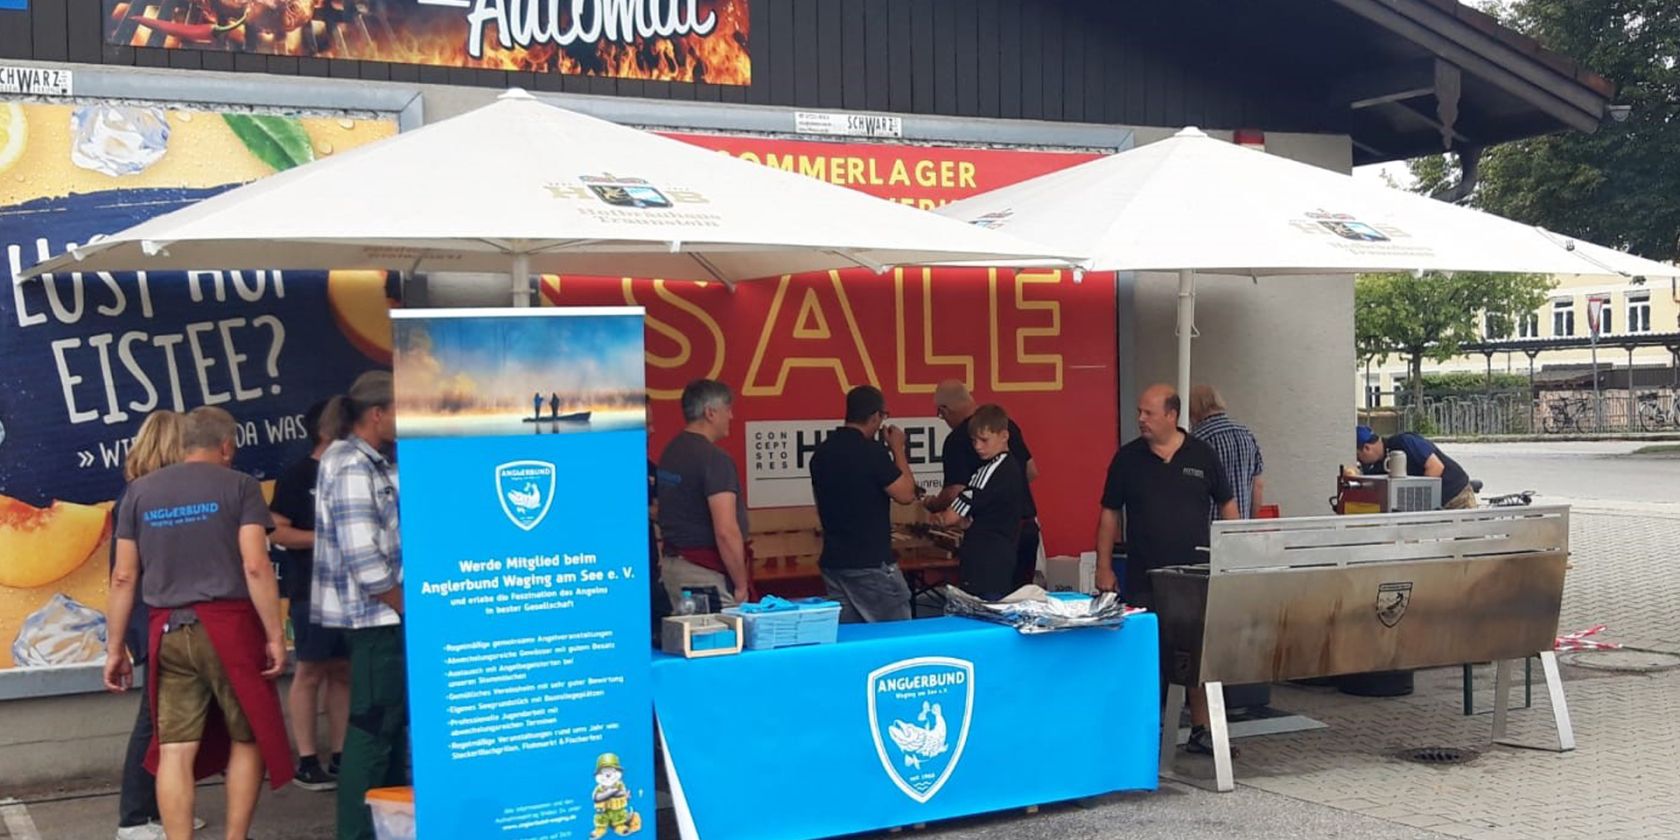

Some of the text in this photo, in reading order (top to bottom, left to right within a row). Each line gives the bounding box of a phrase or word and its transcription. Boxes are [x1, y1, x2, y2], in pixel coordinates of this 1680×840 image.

[0, 68, 59, 93] CHWARZ
[847, 115, 894, 136] SCHWARZ
[715, 149, 977, 188] MMERLAGER
[621, 267, 1064, 400] SALE
[51, 314, 286, 424] EISTEE?
[264, 414, 308, 445] WAS
[755, 442, 788, 450] CEPT
[755, 451, 788, 460] STO
[755, 461, 788, 470] RES
[144, 502, 219, 522] ANGLERBUND
[459, 553, 596, 573] Werde Mitglied beim
[421, 566, 634, 596] Anglerbund Waging am See e. V.
[450, 597, 466, 606] und
[524, 600, 574, 612] Gesellschaft
[878, 671, 965, 693] ANGLERBUND
